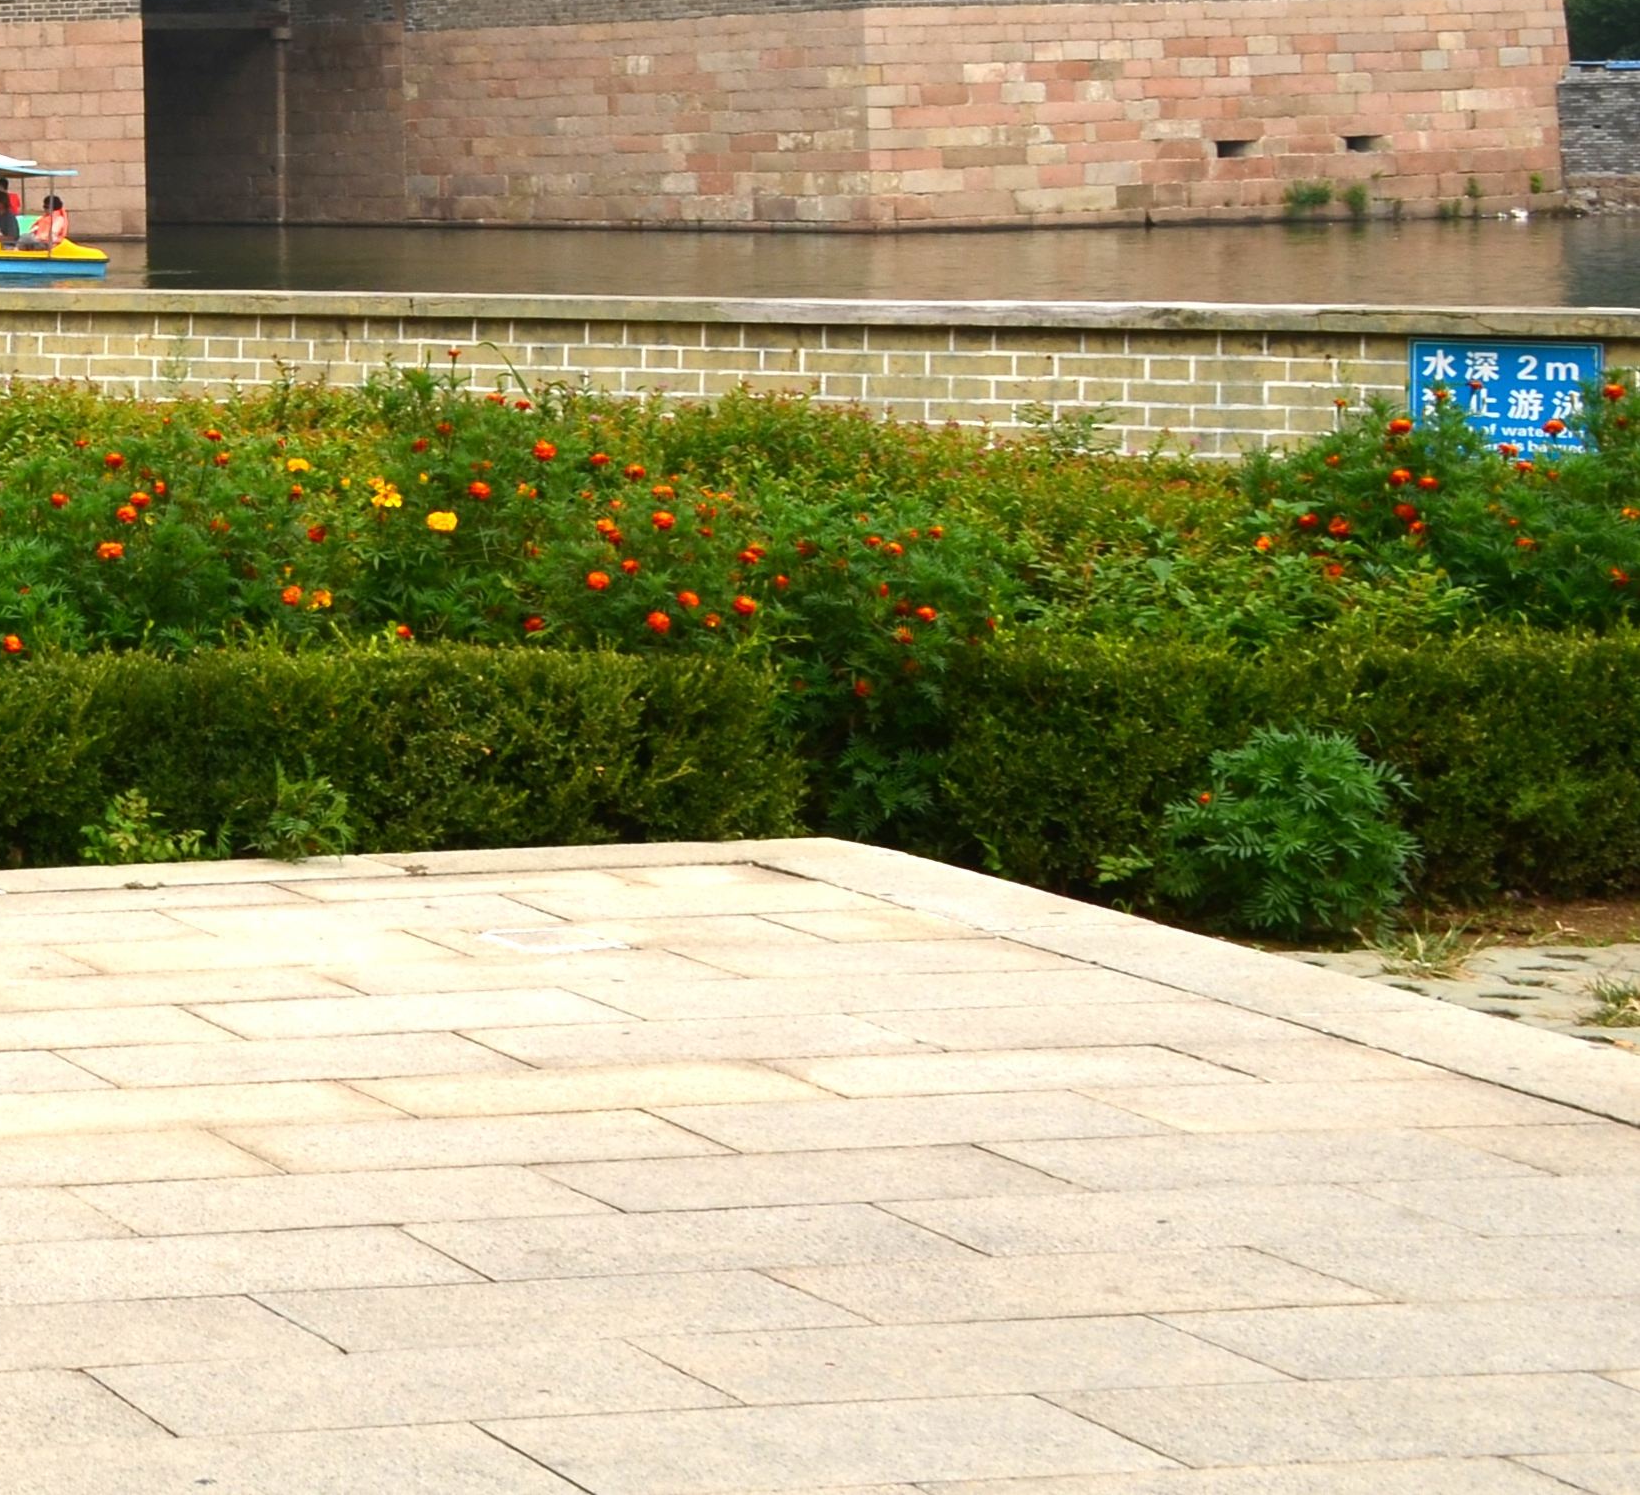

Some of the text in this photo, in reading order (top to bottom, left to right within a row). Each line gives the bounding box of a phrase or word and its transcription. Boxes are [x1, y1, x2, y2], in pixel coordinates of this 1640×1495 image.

[1422, 349, 1580, 382] 水深 2m
[1501, 426, 1550, 437] wate
